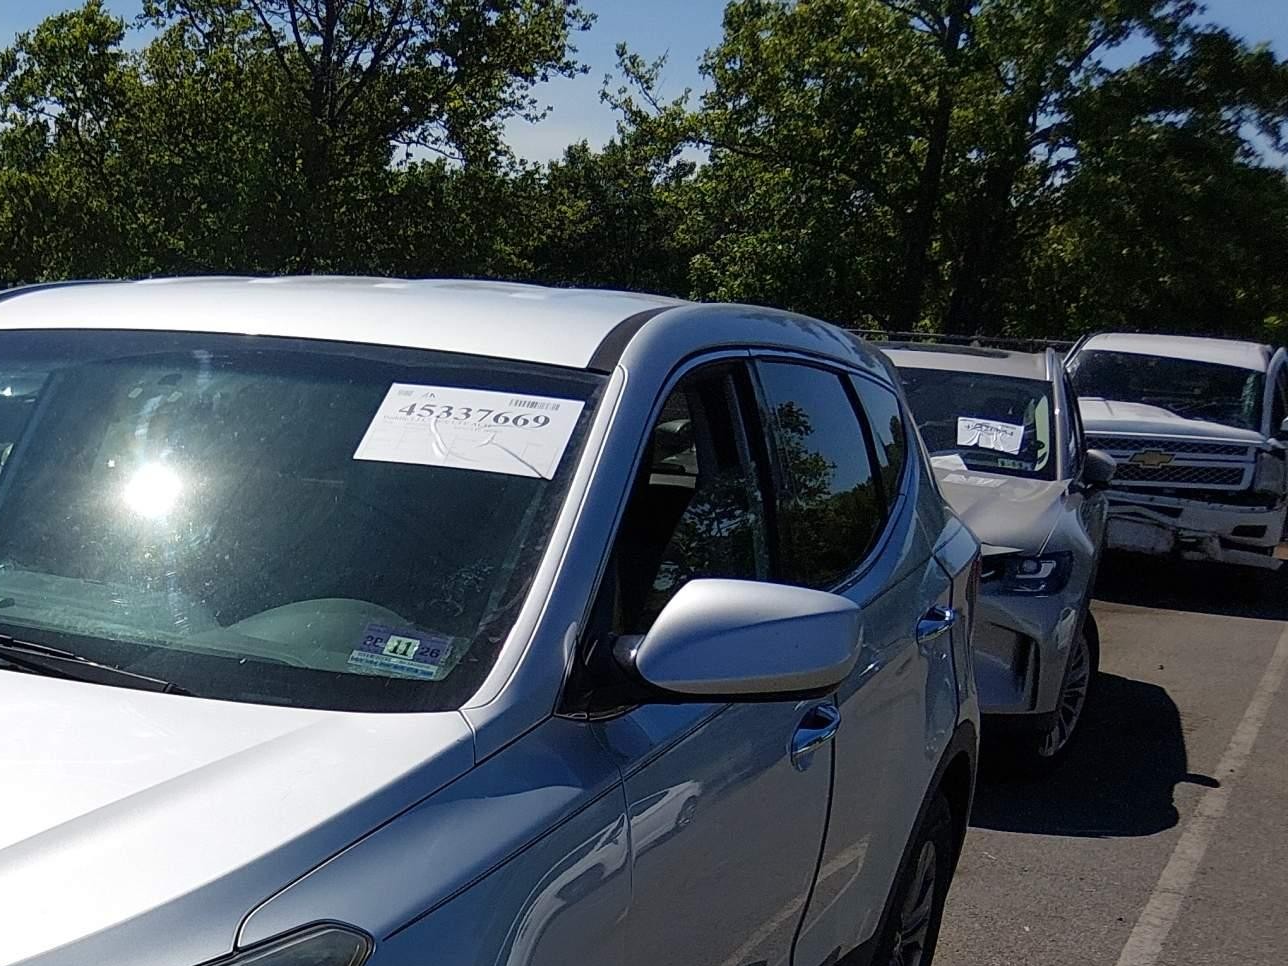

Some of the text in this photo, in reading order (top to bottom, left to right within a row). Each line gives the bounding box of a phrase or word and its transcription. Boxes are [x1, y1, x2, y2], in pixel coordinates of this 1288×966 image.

[398, 403, 551, 429] 45337669
[389, 639, 413, 657] 11
[419, 646, 441, 658] 26
